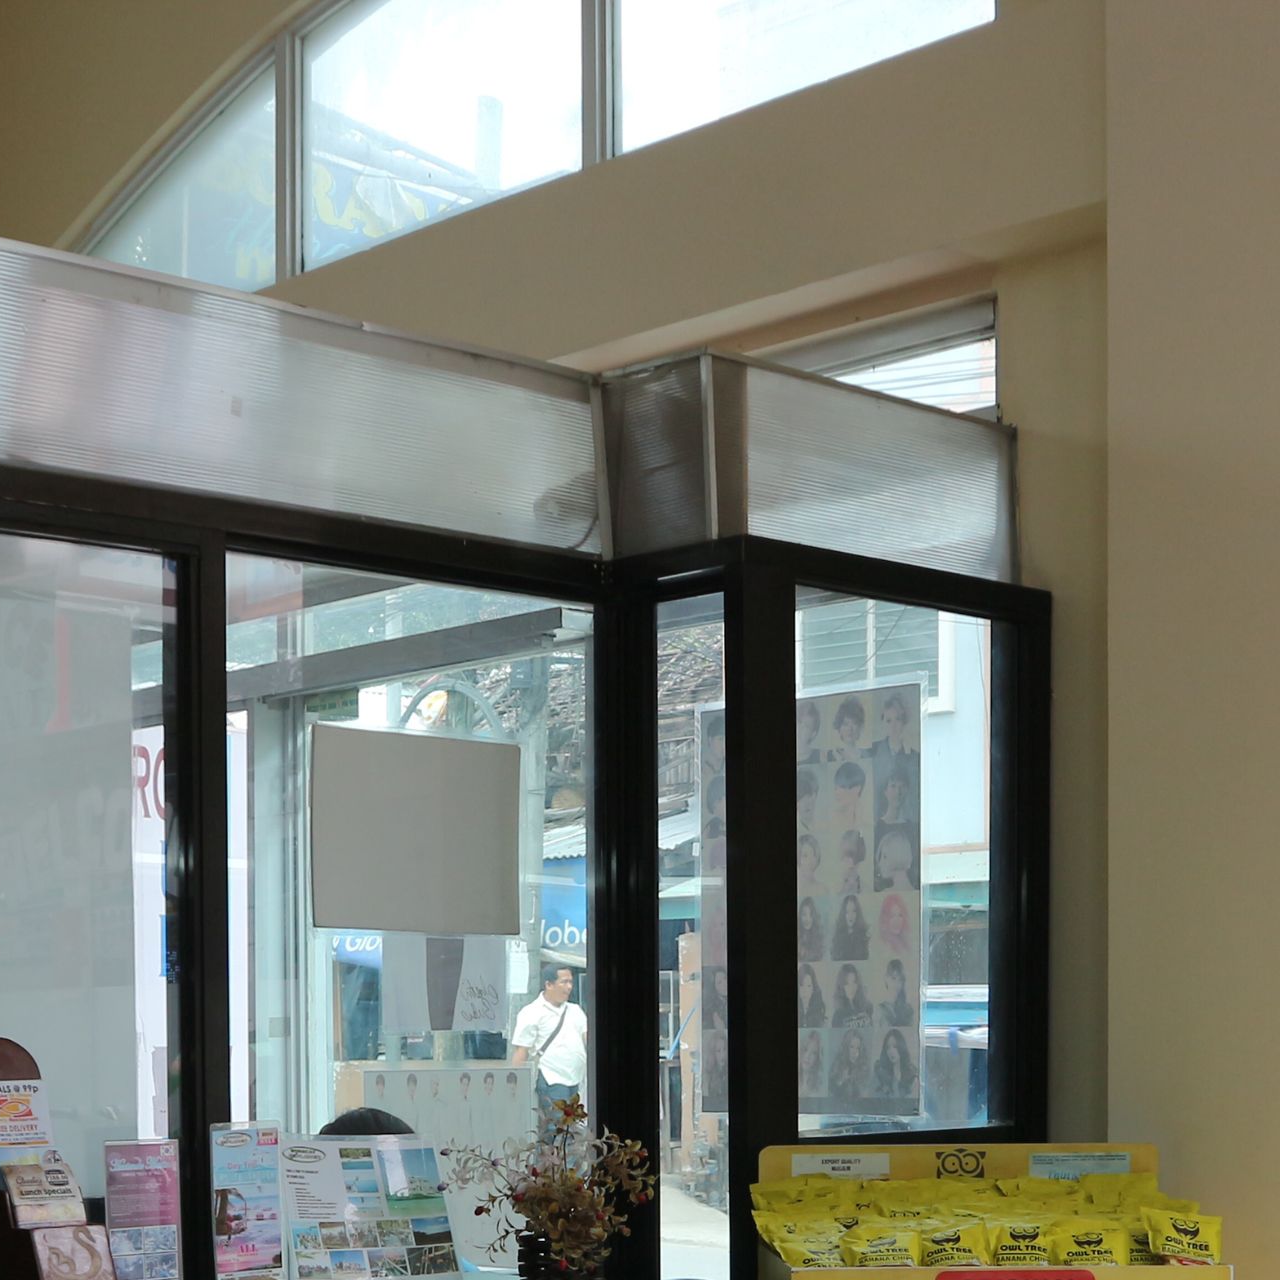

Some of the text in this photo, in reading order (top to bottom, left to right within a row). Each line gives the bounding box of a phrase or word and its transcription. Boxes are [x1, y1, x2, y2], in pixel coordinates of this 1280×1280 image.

[20, 1187, 73, 1197] Lunch Specials
[1000, 1243, 1024, 1252] OWL
[1166, 1235, 1210, 1252] OWL TREE
[927, 1246, 973, 1258] OWL TREE
[1067, 1250, 1091, 1258] OWL
